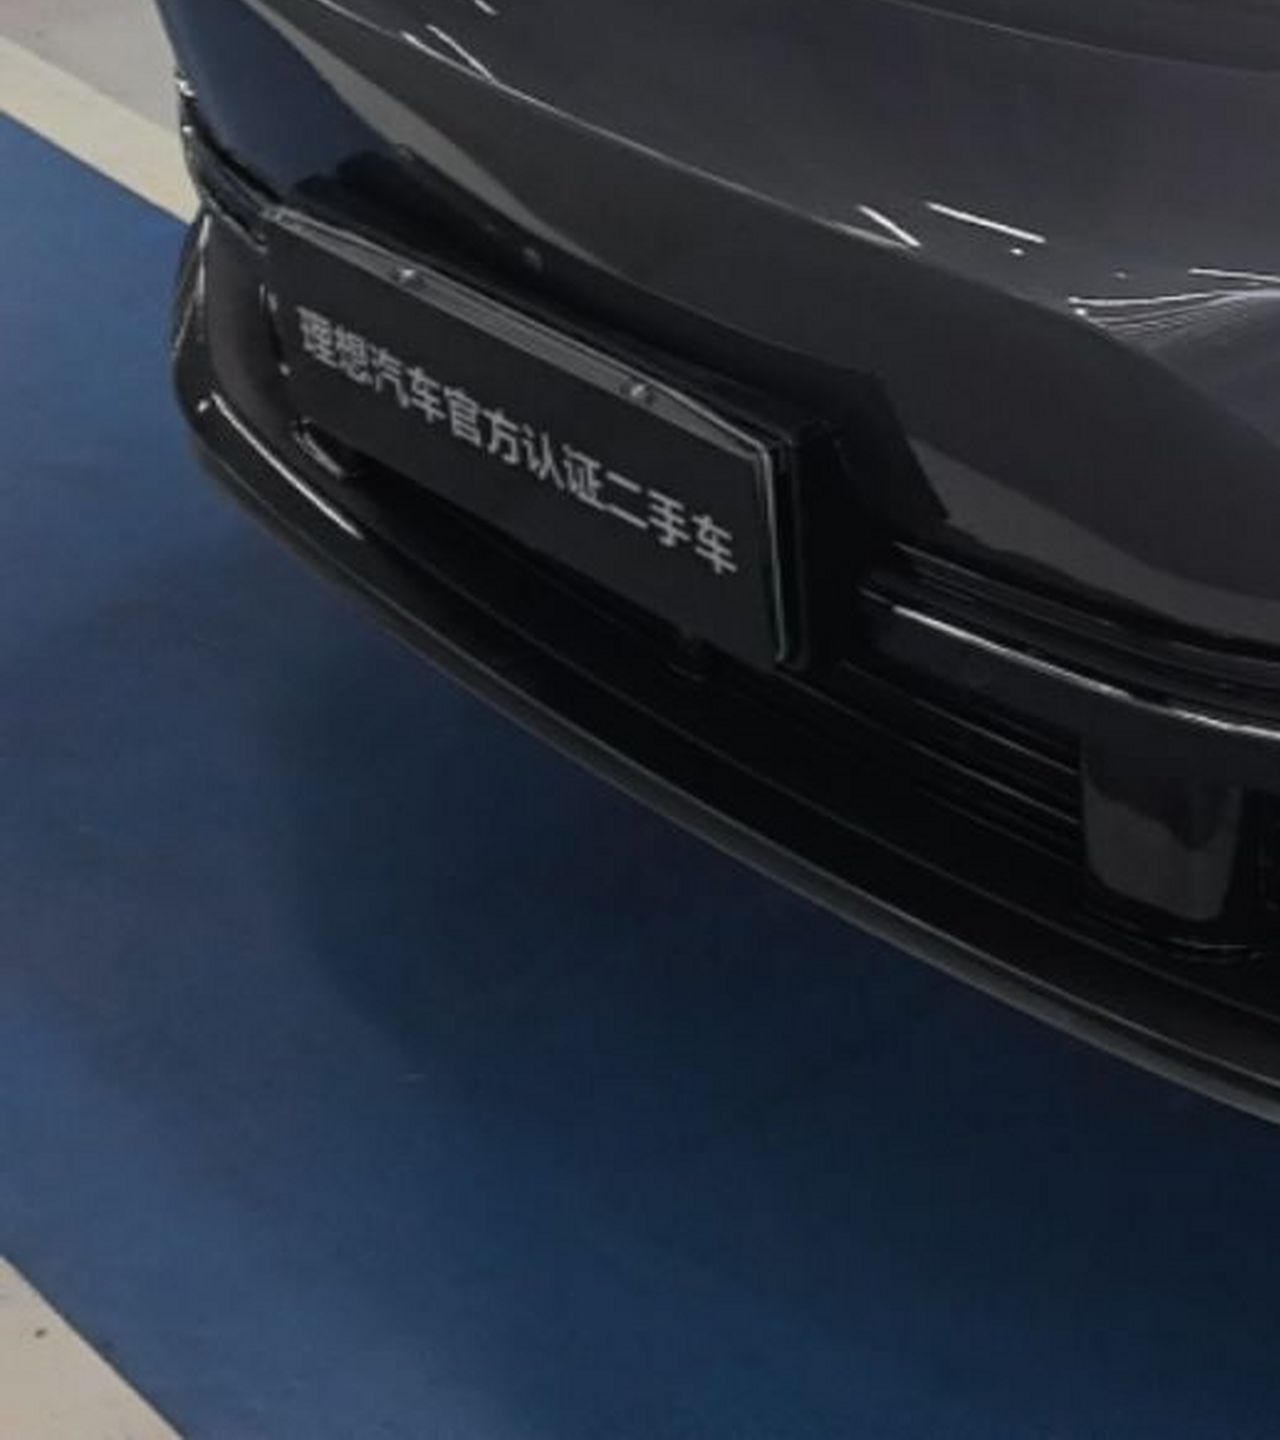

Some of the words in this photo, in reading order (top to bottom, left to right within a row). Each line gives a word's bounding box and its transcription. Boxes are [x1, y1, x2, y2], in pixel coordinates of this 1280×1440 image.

[297, 305, 738, 574] 理想汽车官方认证二手车
